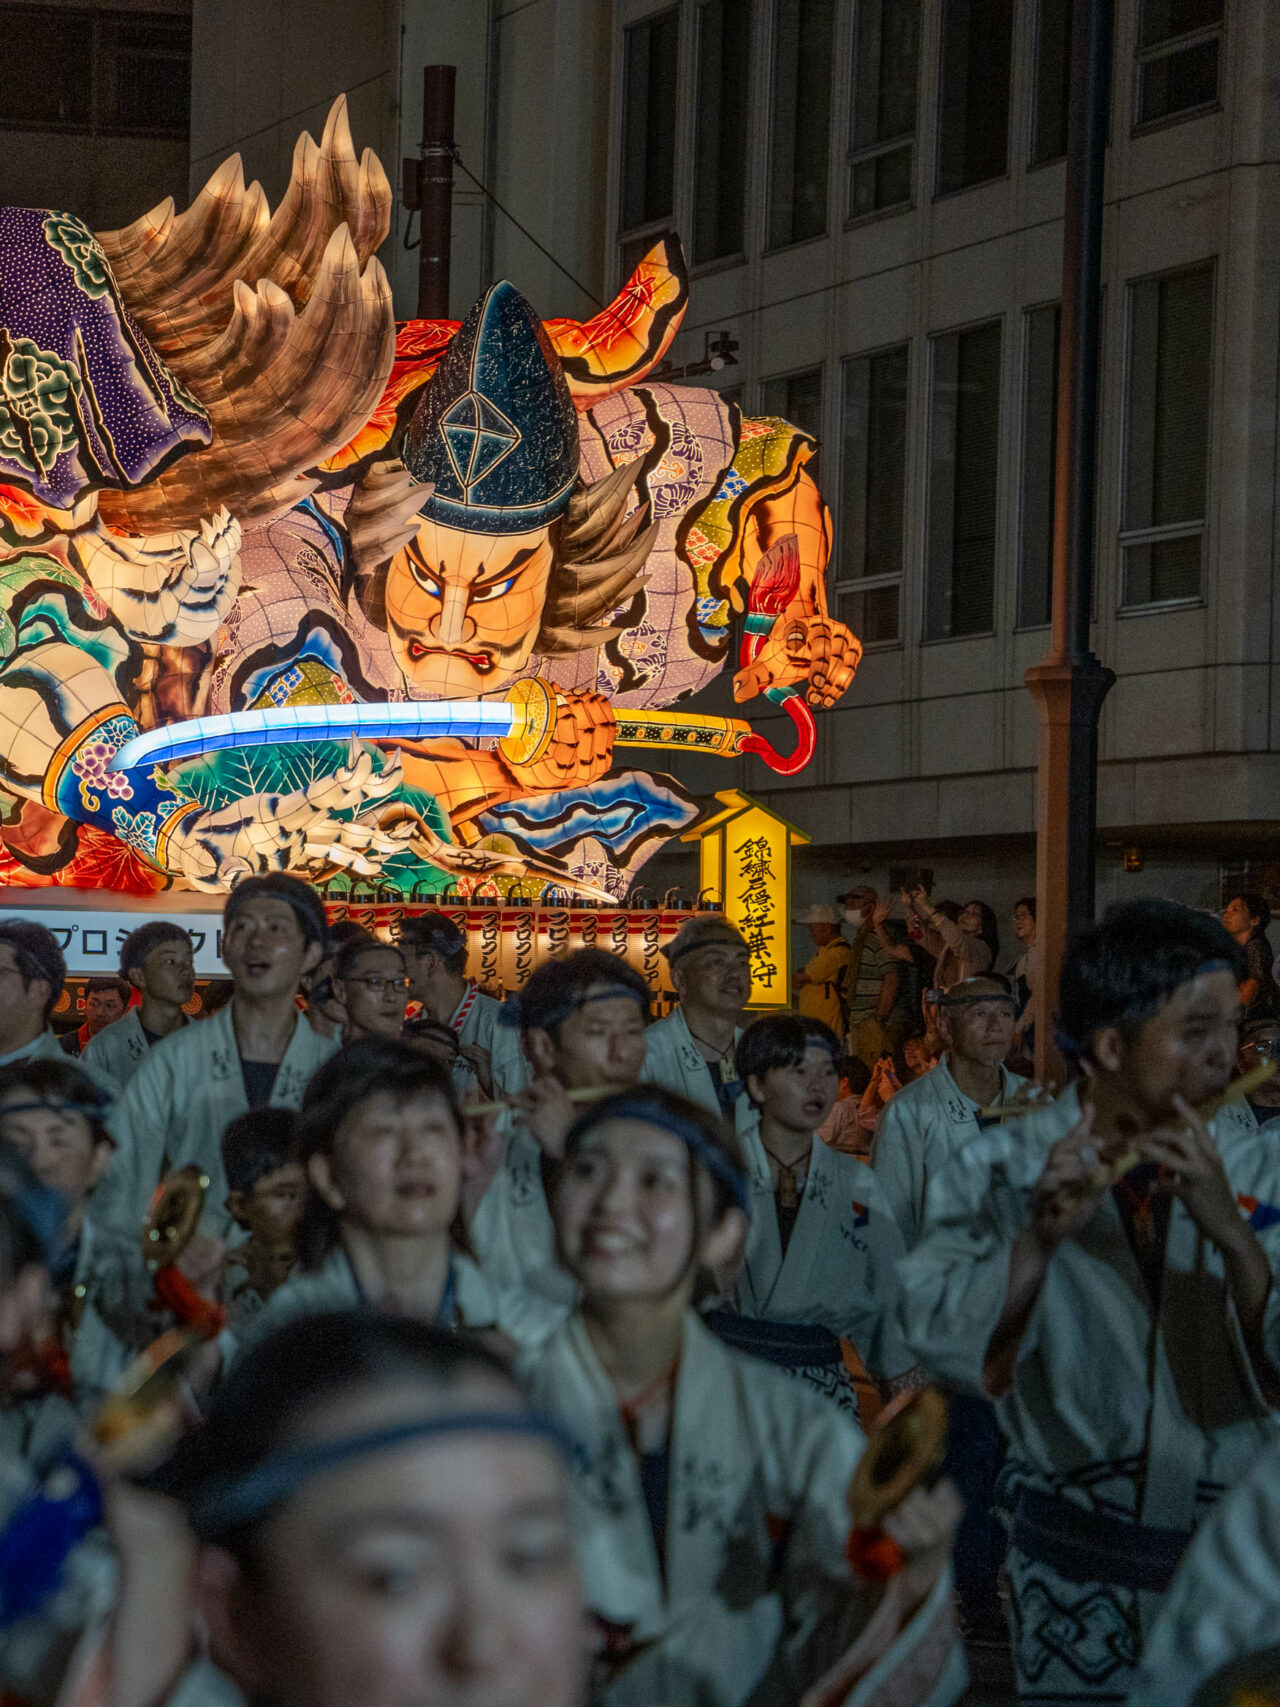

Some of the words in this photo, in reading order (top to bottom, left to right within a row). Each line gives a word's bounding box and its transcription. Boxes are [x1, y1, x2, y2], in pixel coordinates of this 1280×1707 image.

[480, 912, 499, 983] プロクレア
[515, 912, 533, 984] プロクレア
[546, 911, 570, 956] プロク
[611, 915, 629, 956] プロク
[642, 915, 661, 985] プロクレア
